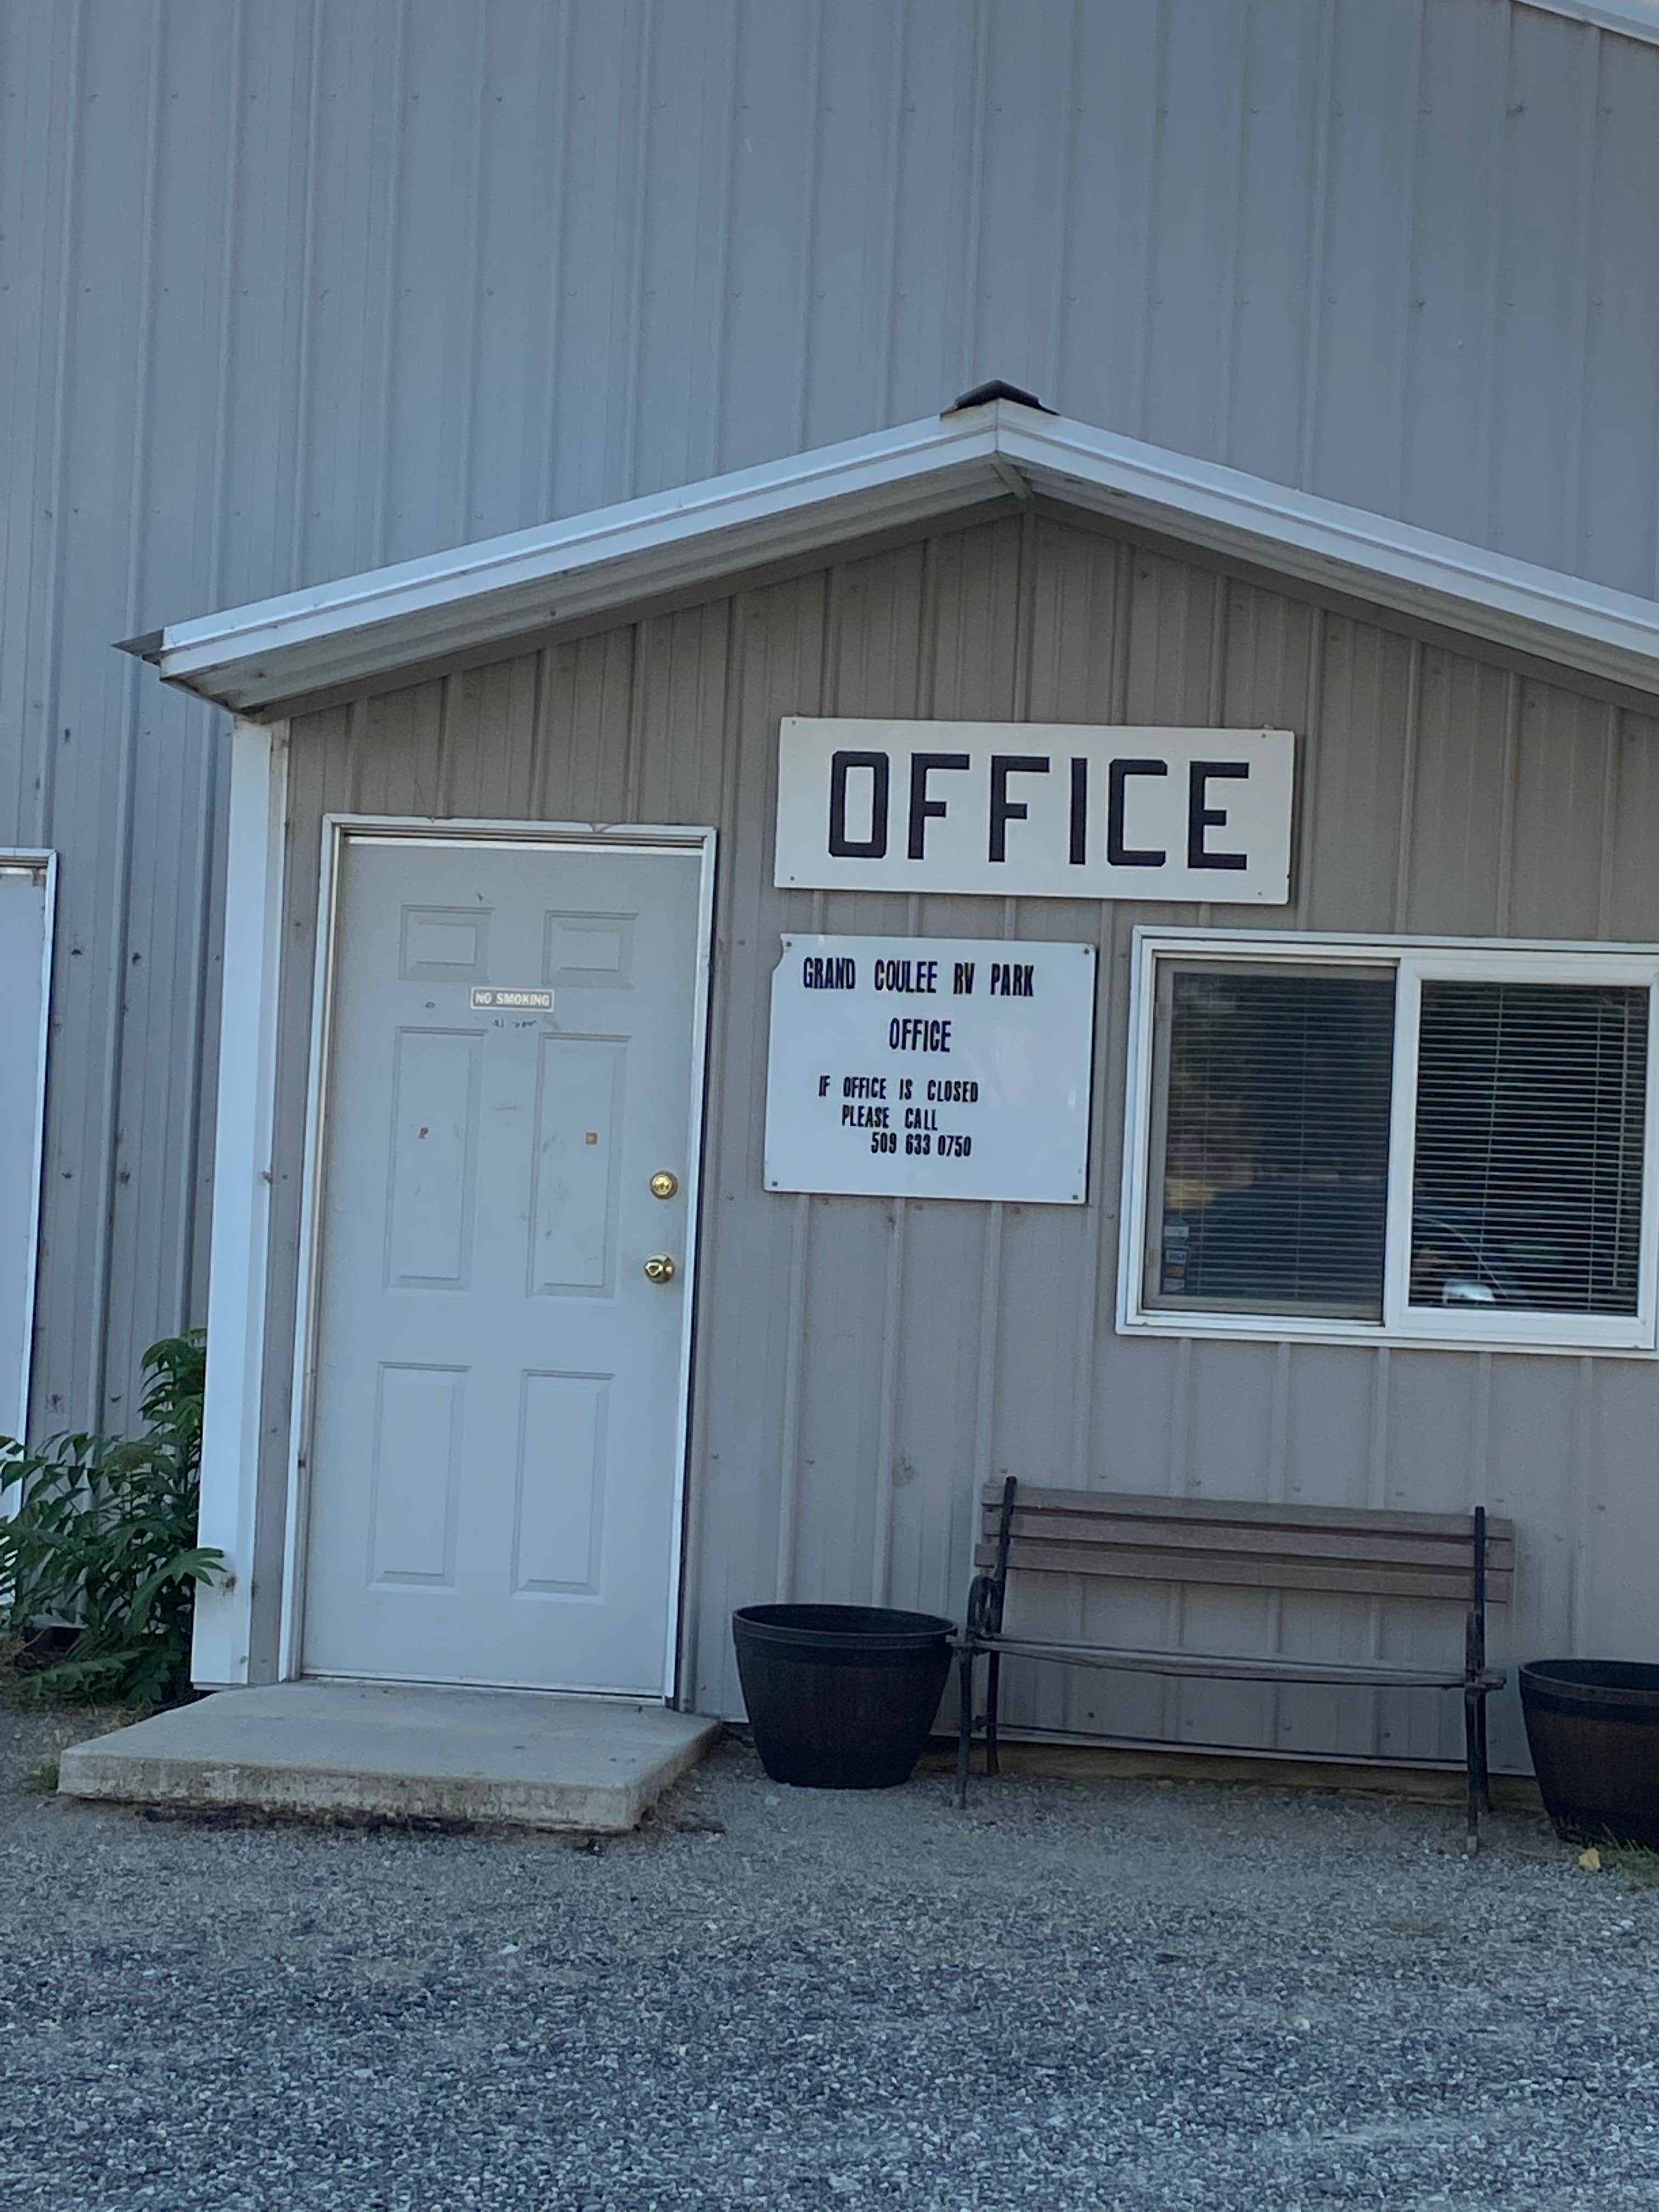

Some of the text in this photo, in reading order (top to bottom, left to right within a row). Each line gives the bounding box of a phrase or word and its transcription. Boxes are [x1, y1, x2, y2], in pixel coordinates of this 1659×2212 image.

[828, 751, 1249, 870] OFFICE
[803, 957, 1035, 997] GRAND COULEE RV PARK
[476, 992, 550, 1006] NO SMOKING
[889, 1018, 952, 1052] OFFICE
[819, 1076, 979, 1103] IF OFFICE IS CLOSED
[842, 1105, 938, 1131] PLEASE CALL
[871, 1132, 972, 1157] 509 633 0750
